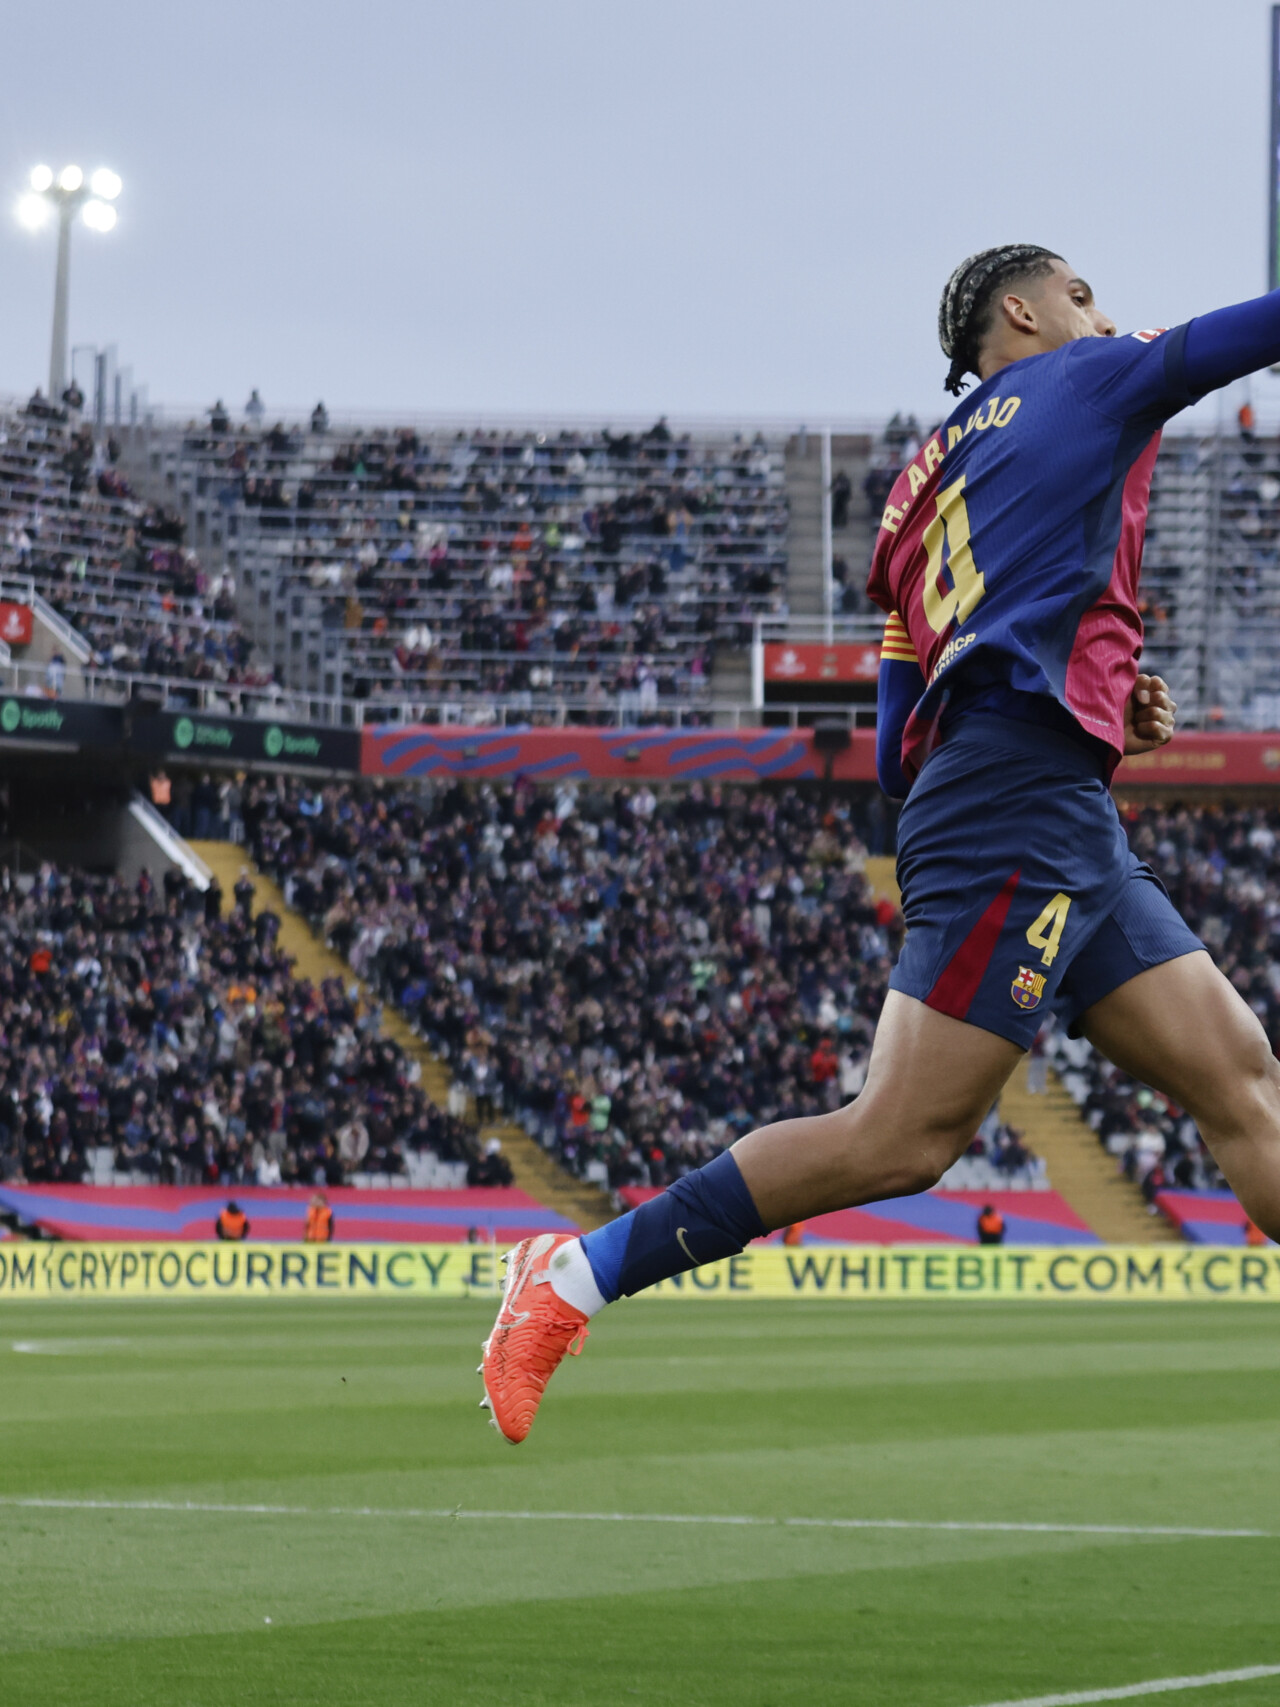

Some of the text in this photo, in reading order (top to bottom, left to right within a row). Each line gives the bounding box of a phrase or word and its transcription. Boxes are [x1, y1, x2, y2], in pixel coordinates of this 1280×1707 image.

[881, 396, 1022, 534] R. ARAUJO
[923, 474, 986, 635] 4
[1026, 892, 1072, 967] 4
[58, 1250, 450, 1289] CRYPTOCURRENCY
[786, 1255, 1163, 1293] WHITEBIT.COM
